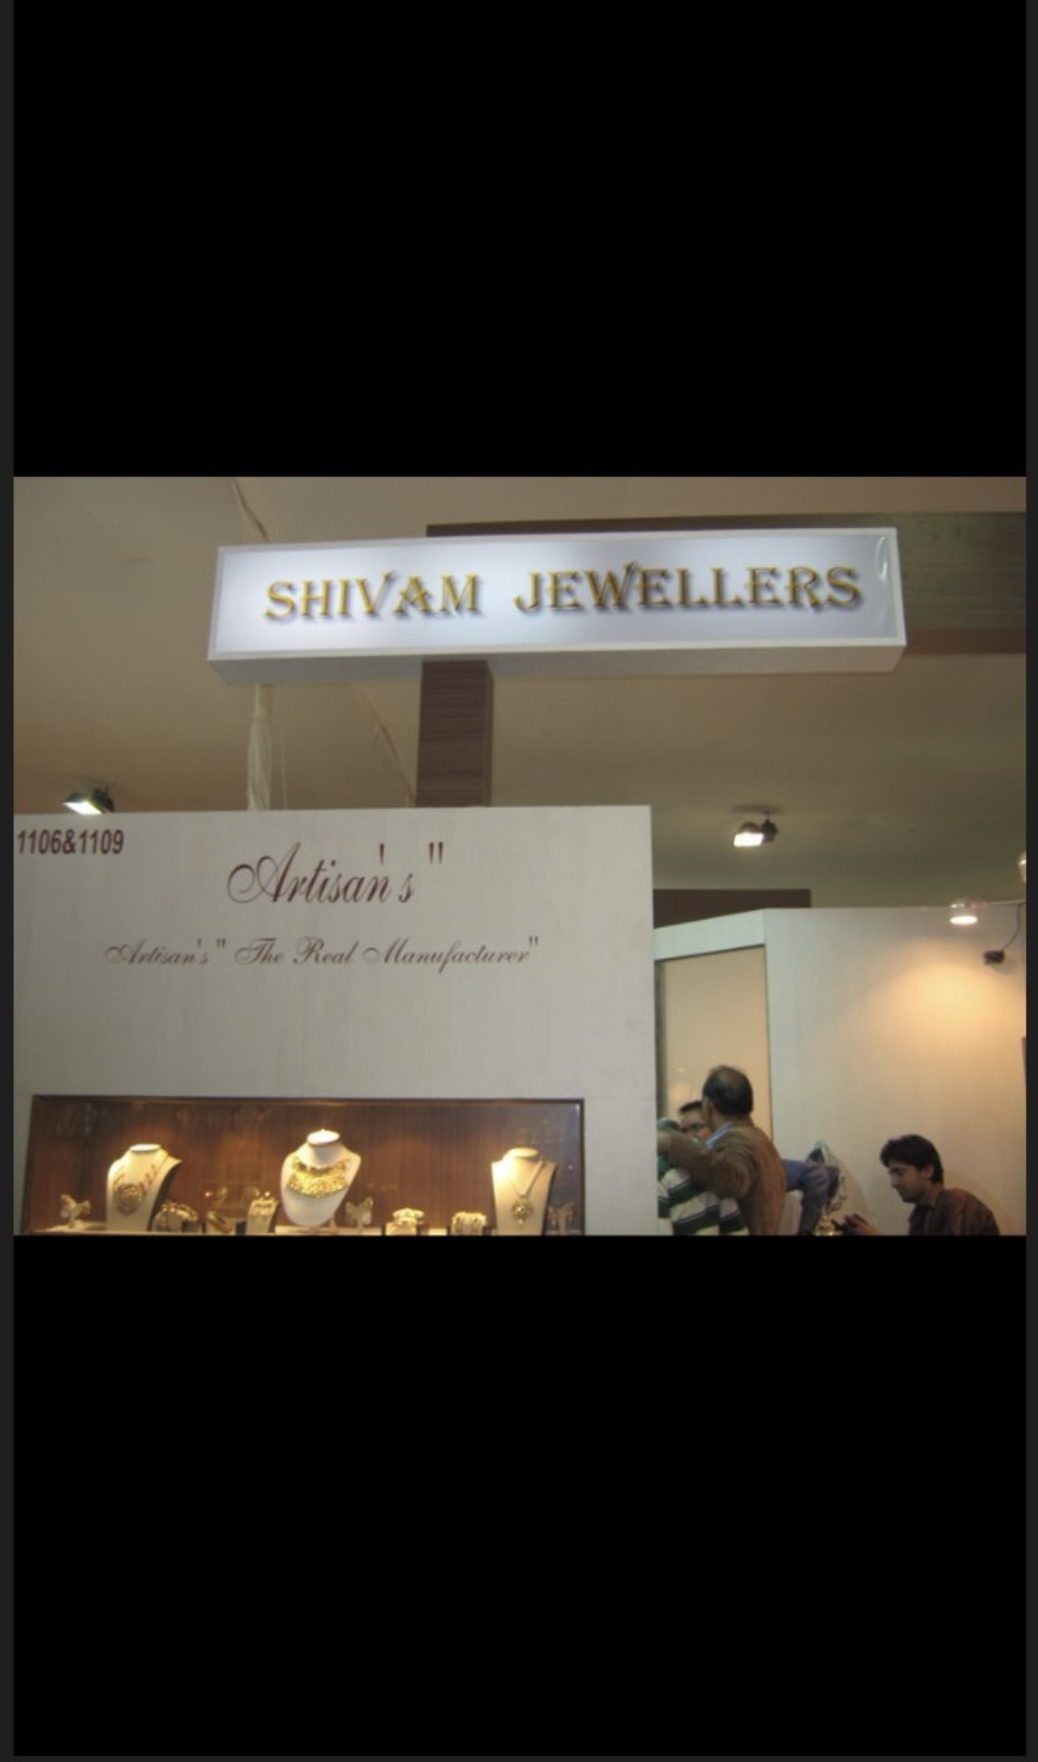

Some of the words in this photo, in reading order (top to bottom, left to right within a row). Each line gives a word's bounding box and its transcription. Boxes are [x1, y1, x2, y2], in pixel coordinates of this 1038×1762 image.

[265, 571, 482, 620] SHIVAM
[514, 560, 864, 613] JEWELLERS
[18, 828, 125, 855] 1106&1109
[292, 936, 359, 966] Real
